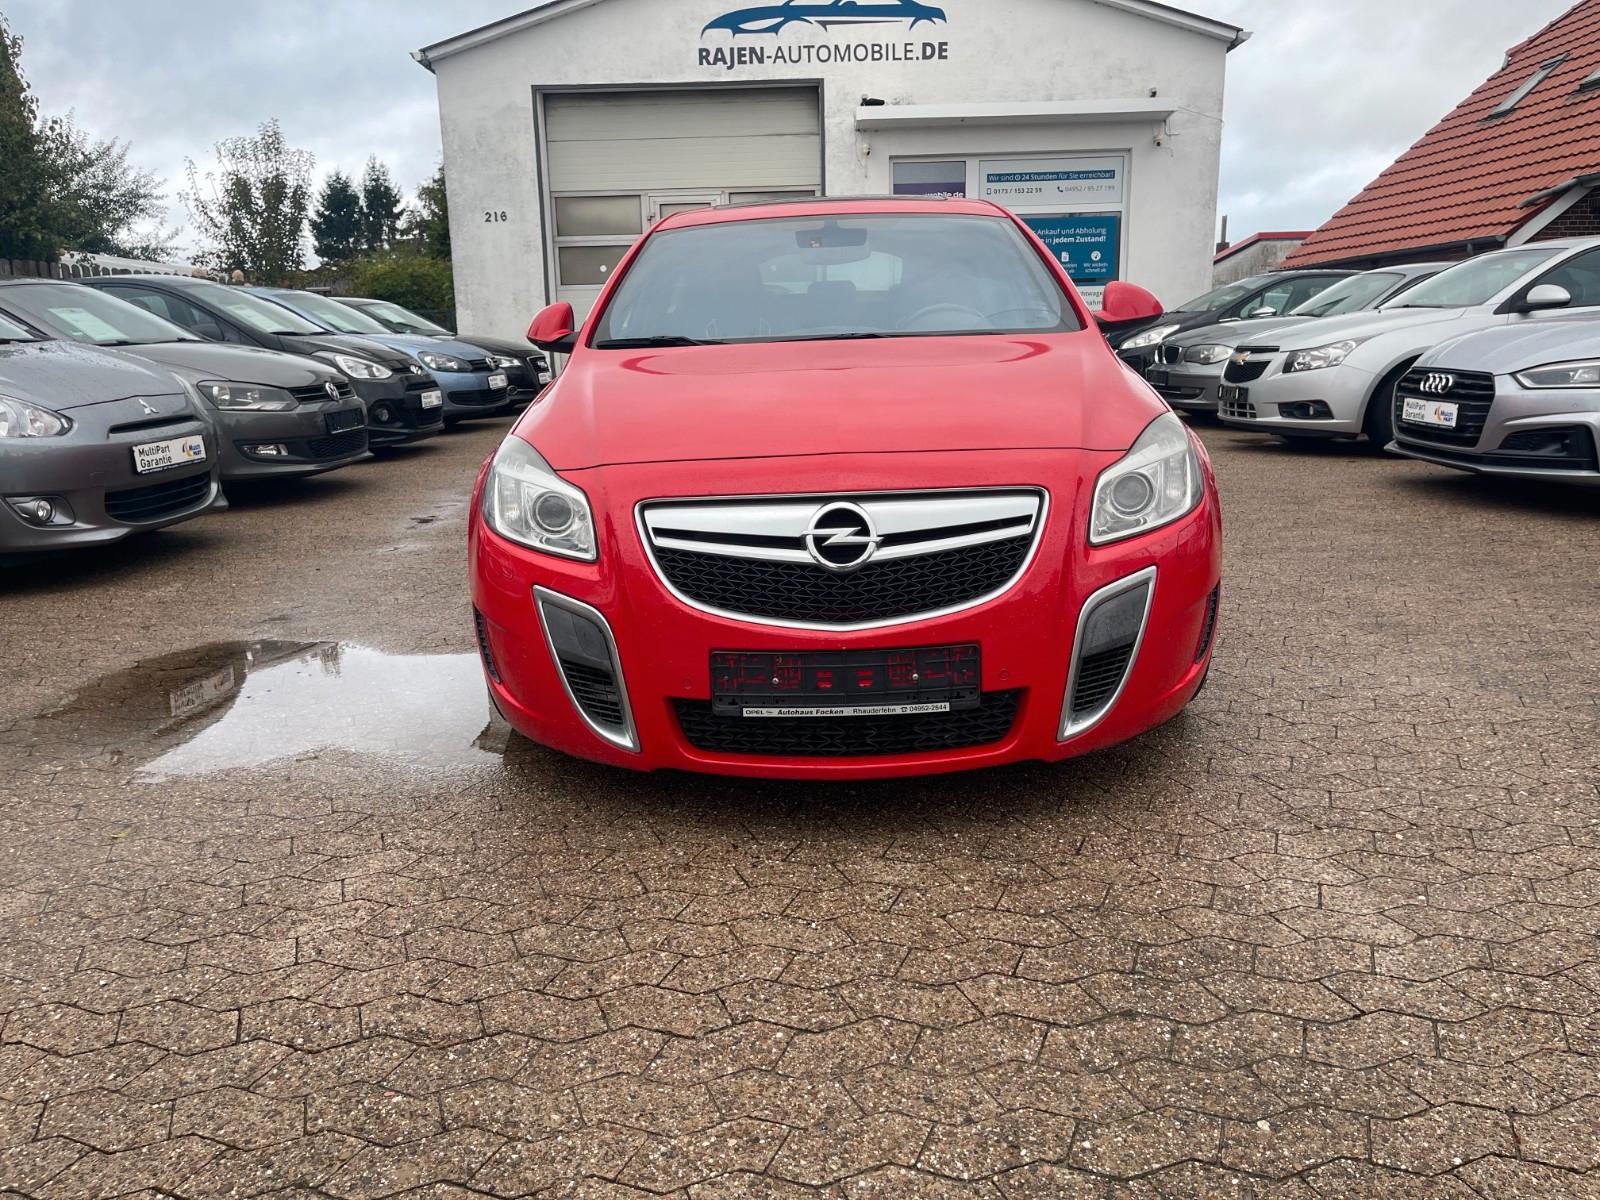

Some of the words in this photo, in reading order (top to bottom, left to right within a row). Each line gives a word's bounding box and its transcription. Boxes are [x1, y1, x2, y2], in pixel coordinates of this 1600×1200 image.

[698, 42, 949, 70] RAJEN-AUTOMOBILE.DE
[1031, 173, 1058, 181] Stunden
[1058, 172, 1068, 180] für
[1069, 172, 1079, 180] Sie
[1080, 171, 1114, 179] erreichbar!
[484, 211, 508, 223] 216
[1037, 228, 1060, 236] Ankauf
[1075, 227, 1107, 235] Abholung
[1053, 236, 1075, 245] jedem
[1075, 235, 1106, 243] Zustand!
[138, 444, 171, 457] MultiPart
[140, 455, 173, 469] Garantie
